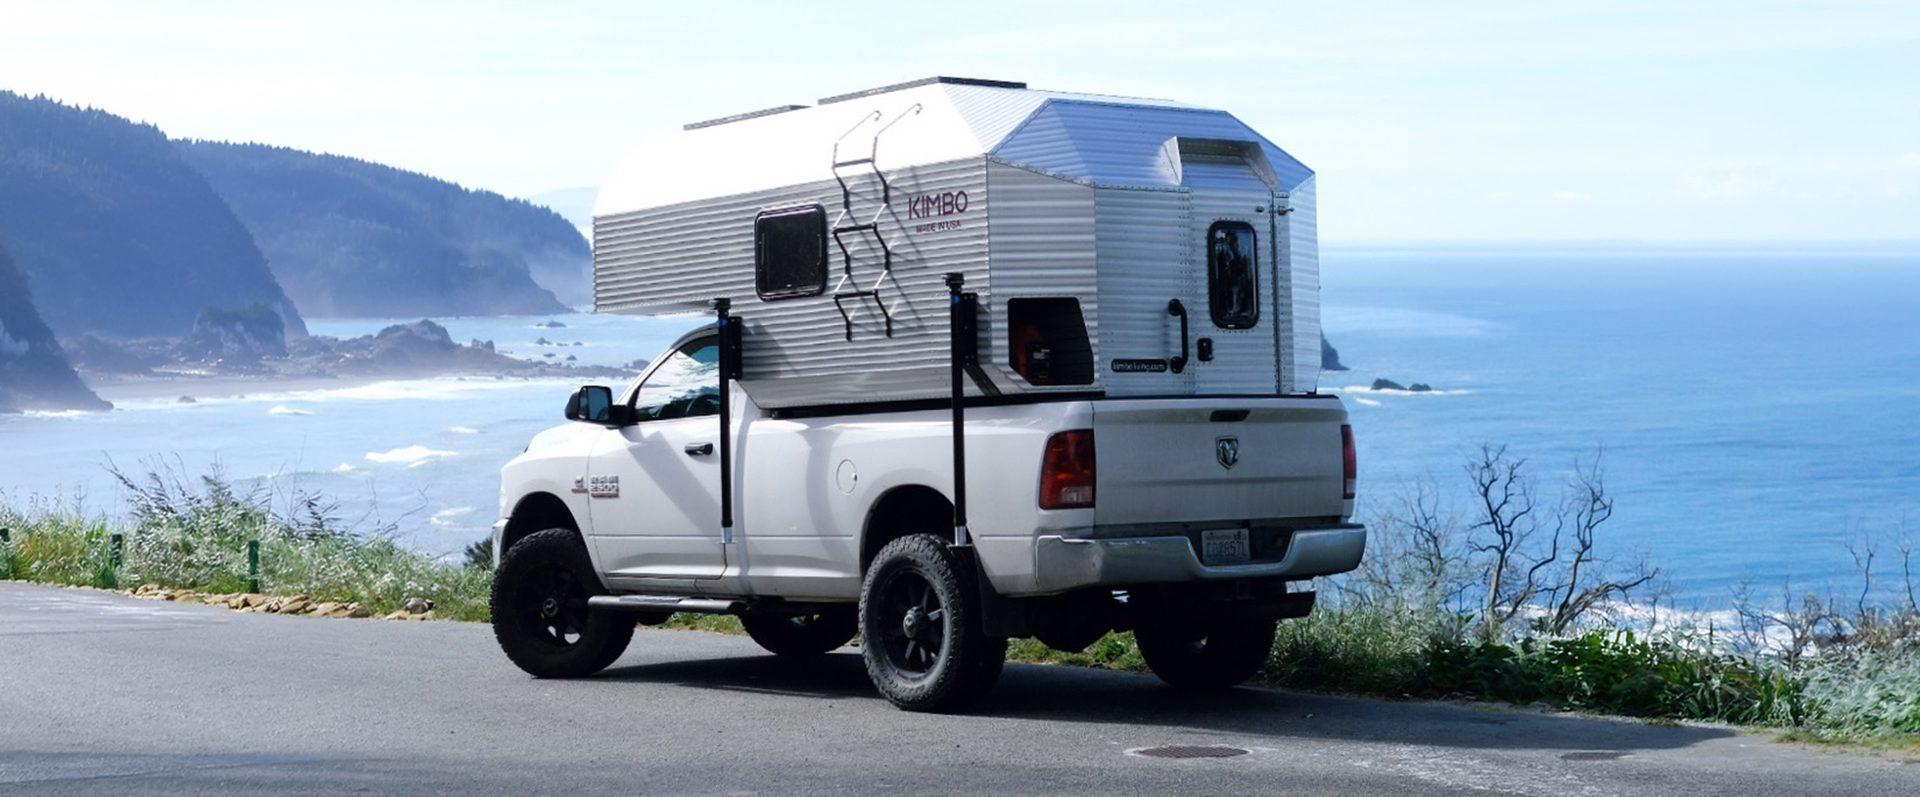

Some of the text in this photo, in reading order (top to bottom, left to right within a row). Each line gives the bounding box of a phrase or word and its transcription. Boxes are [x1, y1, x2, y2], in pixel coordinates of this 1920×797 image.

[909, 190, 968, 220] KIMBO
[916, 222, 936, 233] MADE
[946, 219, 961, 230] USA
